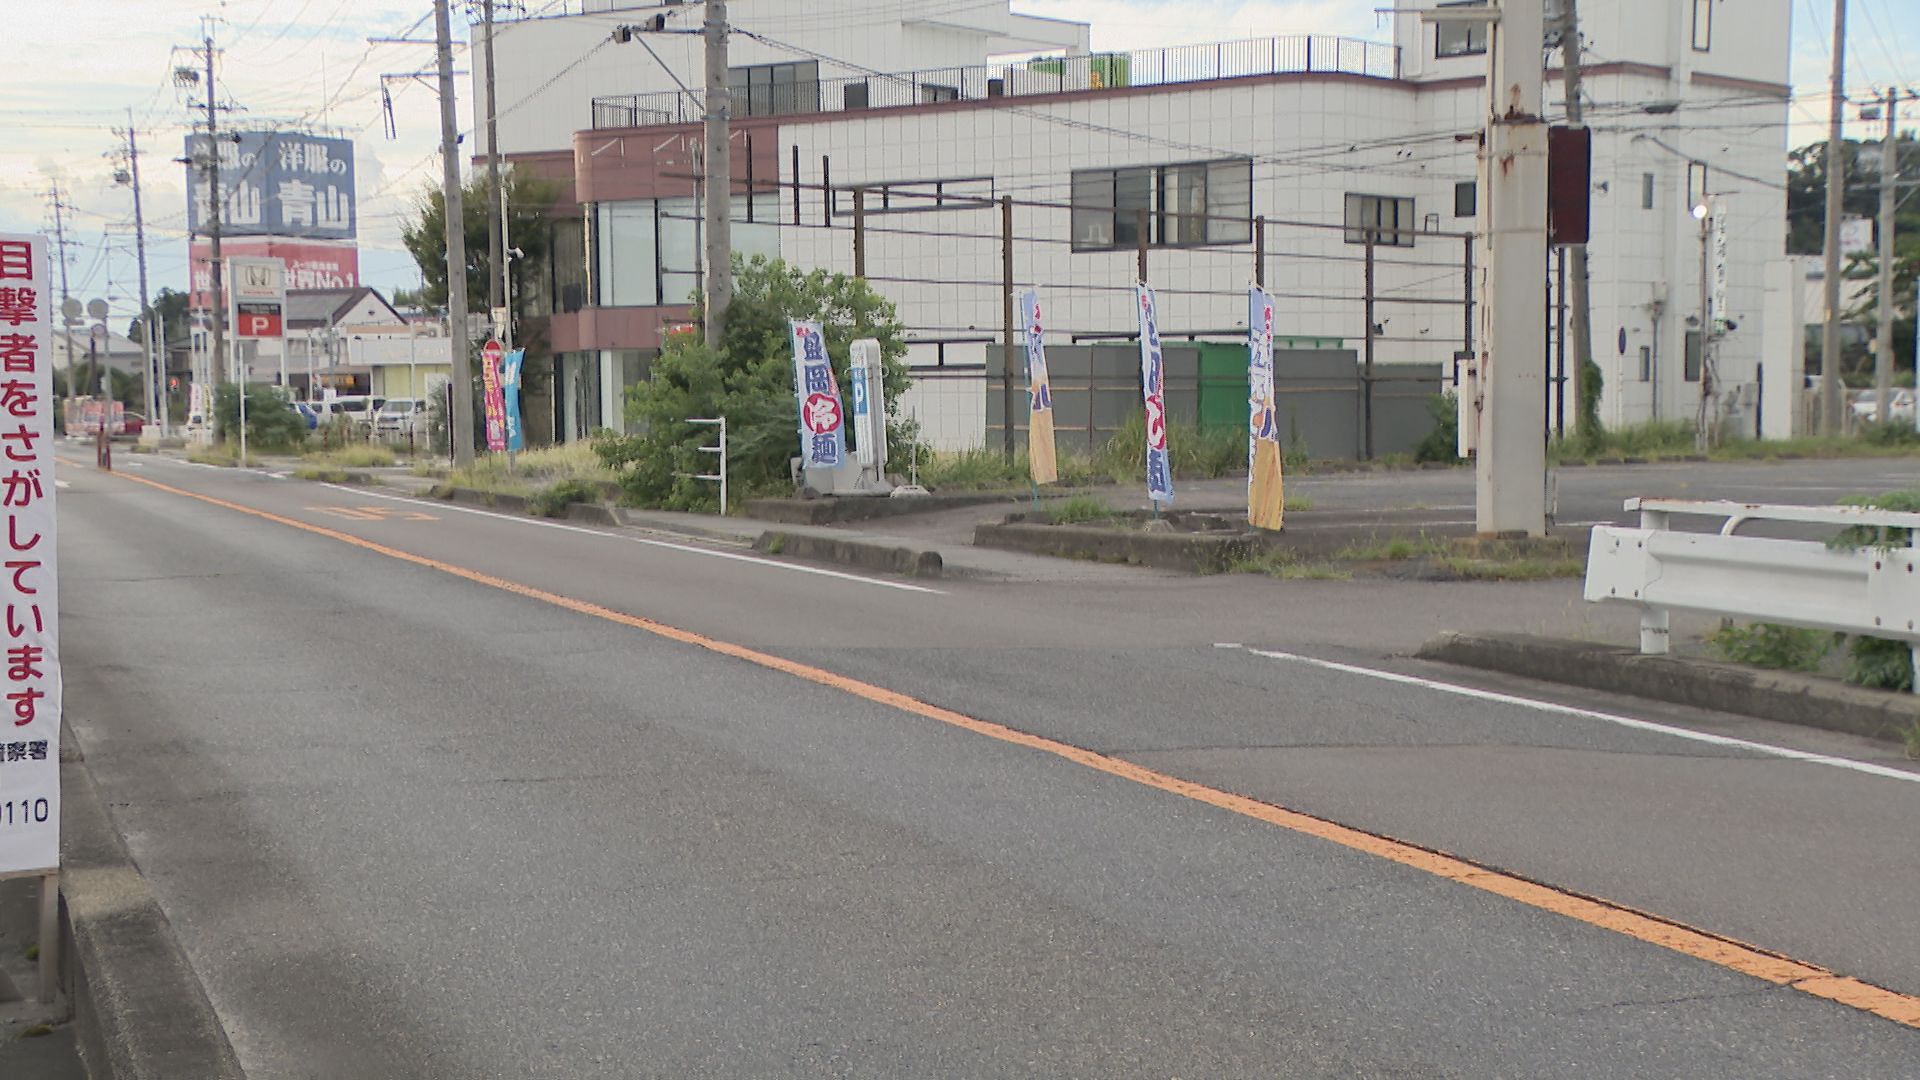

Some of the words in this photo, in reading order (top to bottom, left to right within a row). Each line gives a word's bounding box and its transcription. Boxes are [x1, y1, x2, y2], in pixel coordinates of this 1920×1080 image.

[279, 141, 347, 175] 洋服の
[194, 180, 261, 227] 青山
[278, 179, 349, 231] 青山
[252, 317, 269, 335] P
[855, 382, 864, 412] P
[0, 241, 45, 727] 目撃者をさがしています
[0, 740, 48, 762] 察署
[0, 798, 48, 825] 110
